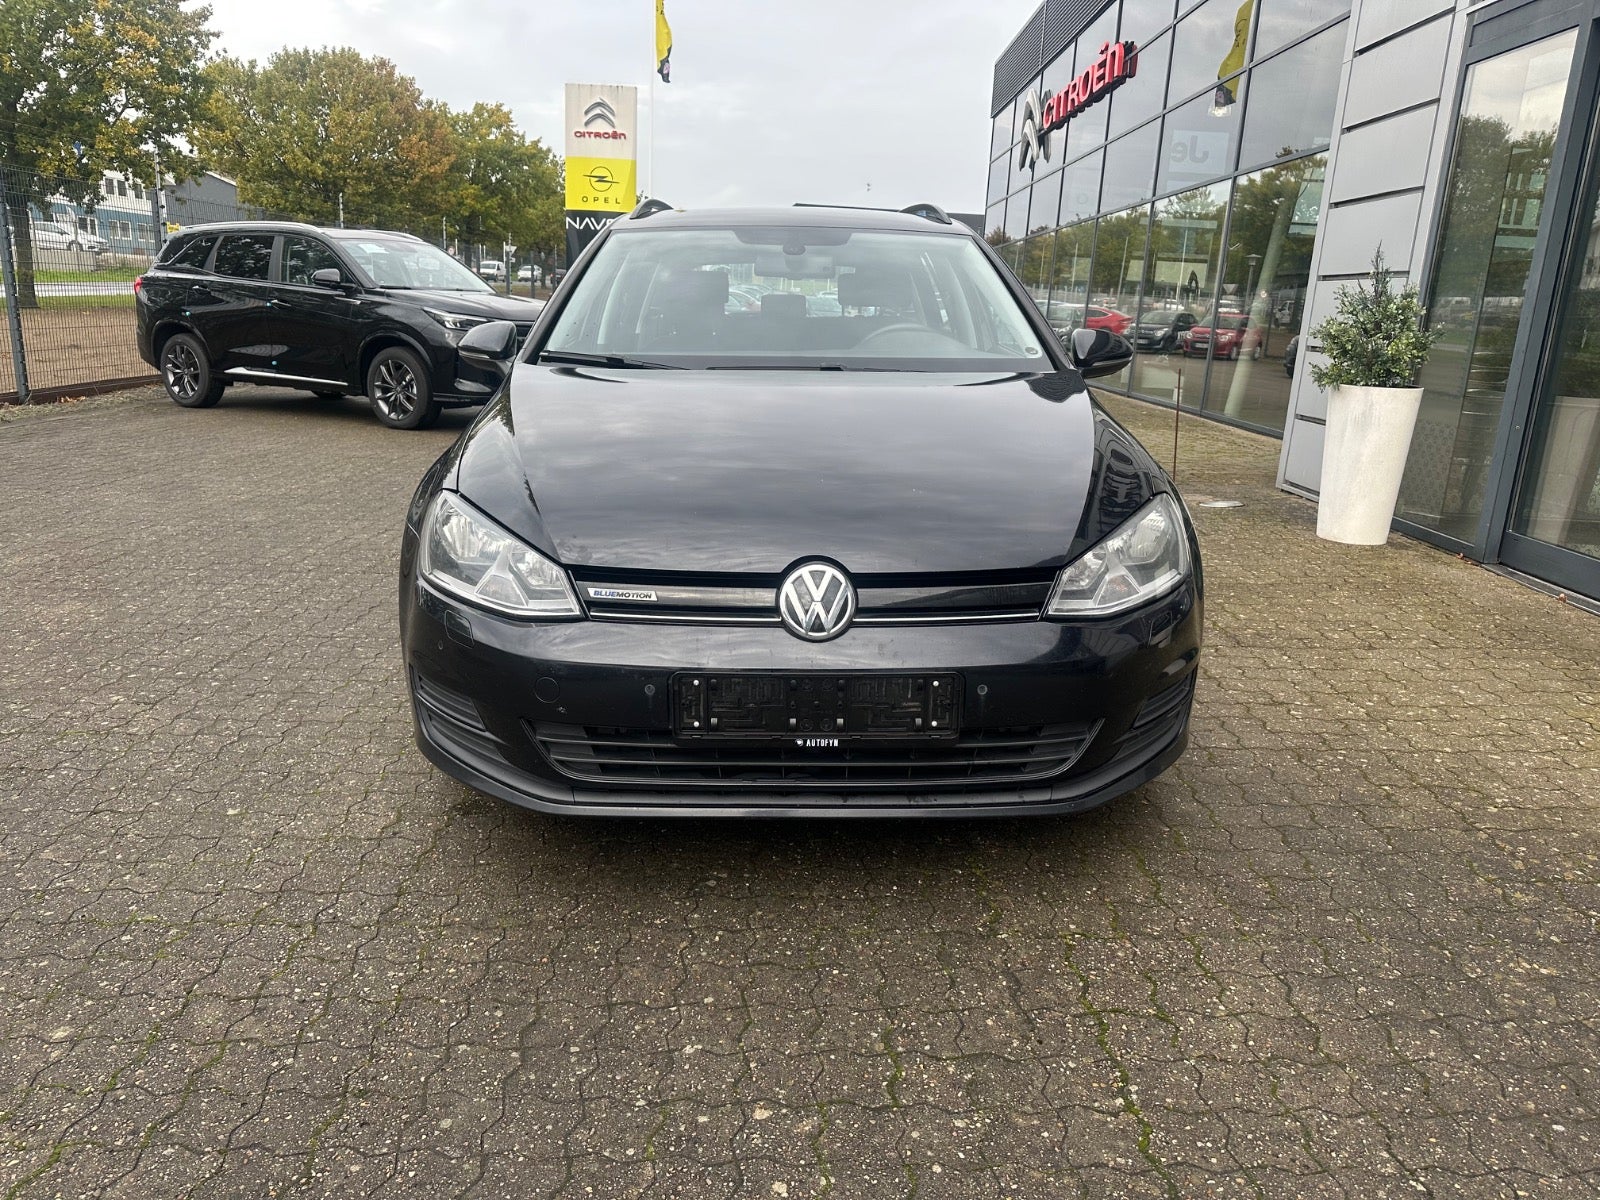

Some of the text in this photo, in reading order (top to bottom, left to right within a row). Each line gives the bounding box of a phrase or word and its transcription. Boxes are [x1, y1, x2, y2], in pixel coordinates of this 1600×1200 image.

[582, 196, 621, 205] OPEL
[594, 590, 652, 599] BLUEMOTION
[806, 738, 839, 747] AUTOFYN
